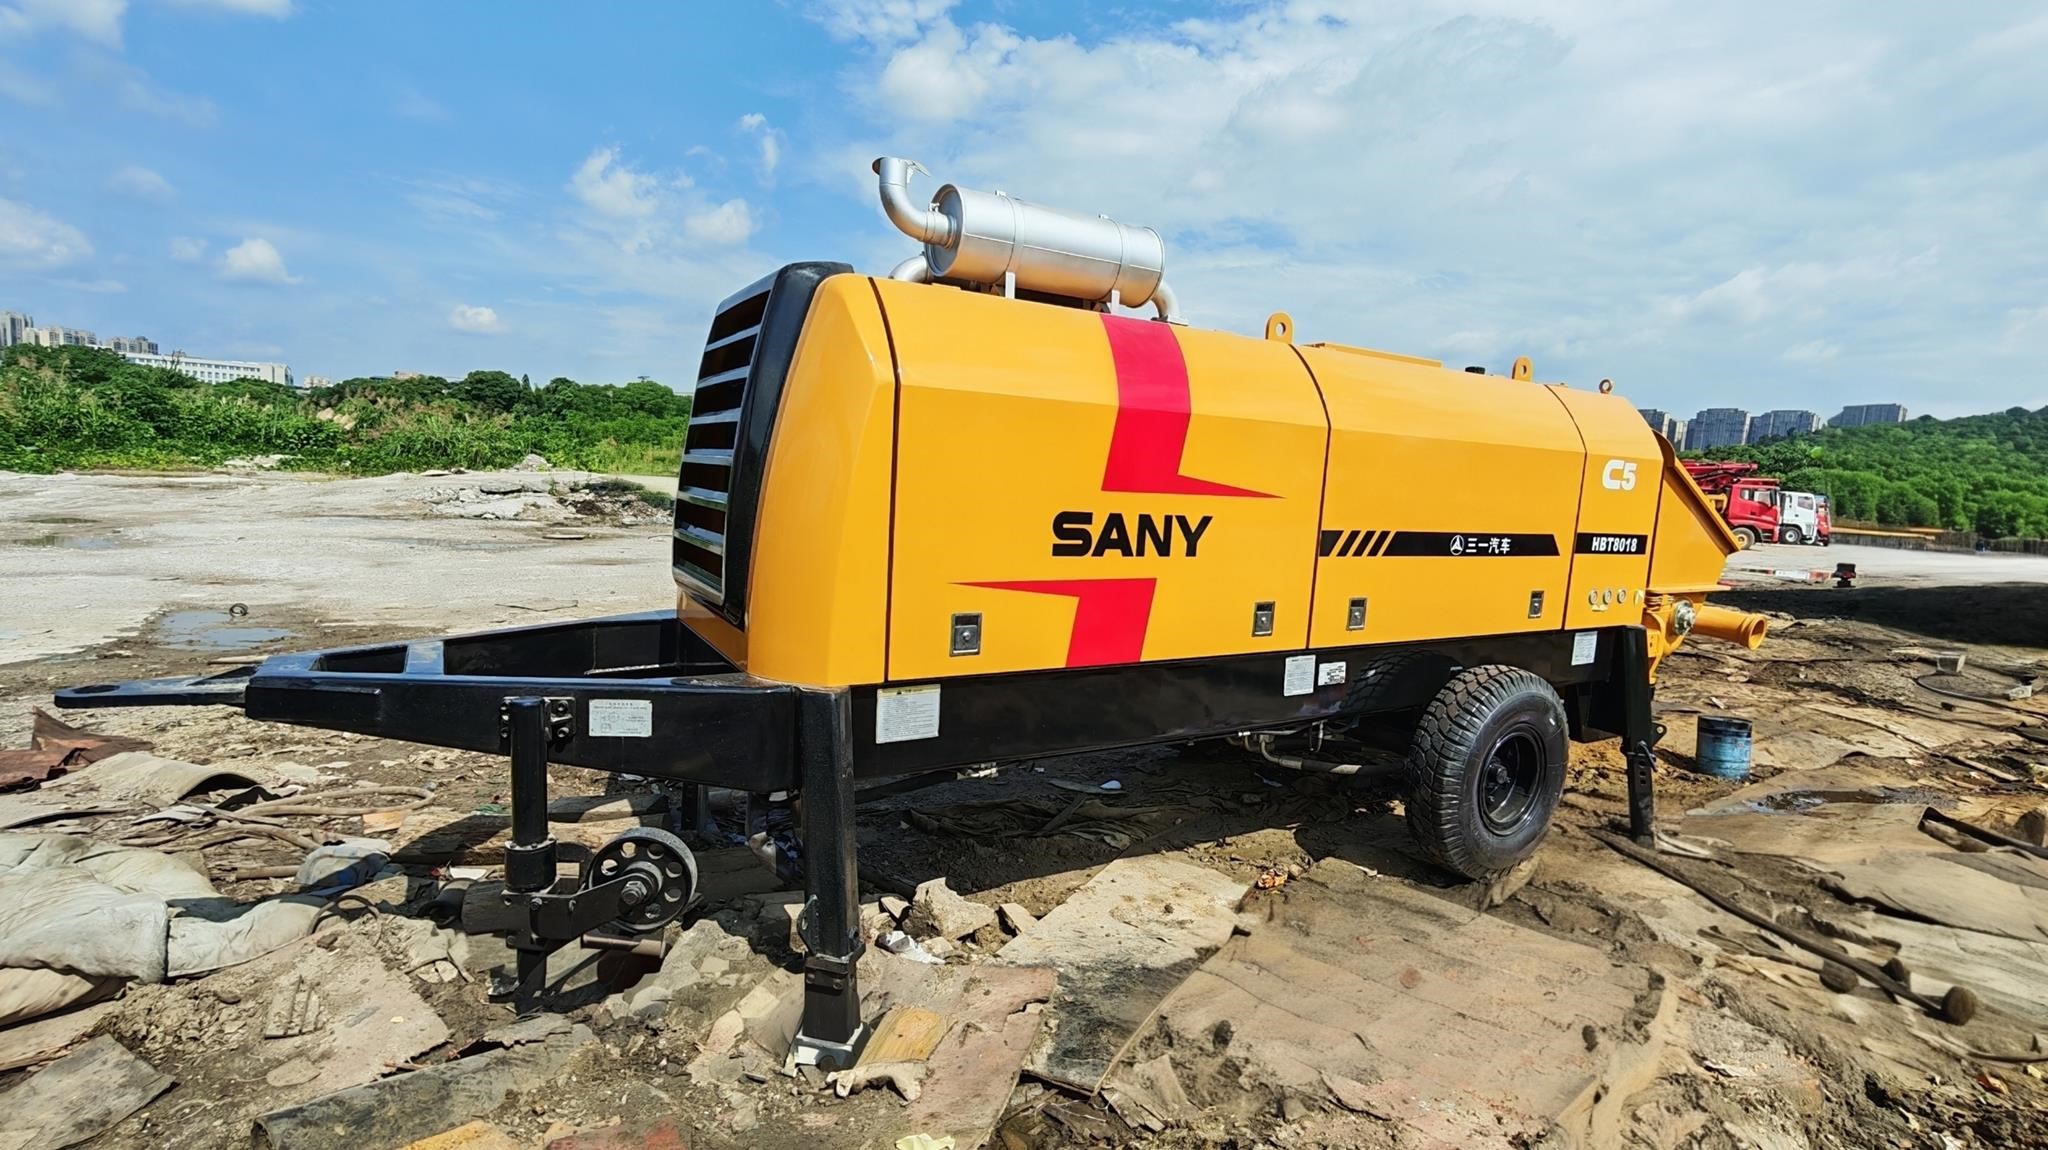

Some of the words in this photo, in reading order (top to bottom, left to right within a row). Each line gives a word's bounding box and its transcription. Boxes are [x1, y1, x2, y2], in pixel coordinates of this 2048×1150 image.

[1602, 459, 1637, 490] C5
[1052, 511, 1213, 557] SANY
[1466, 538, 1511, 554] 三一汽车
[1592, 536, 1637, 553] HBT8018
